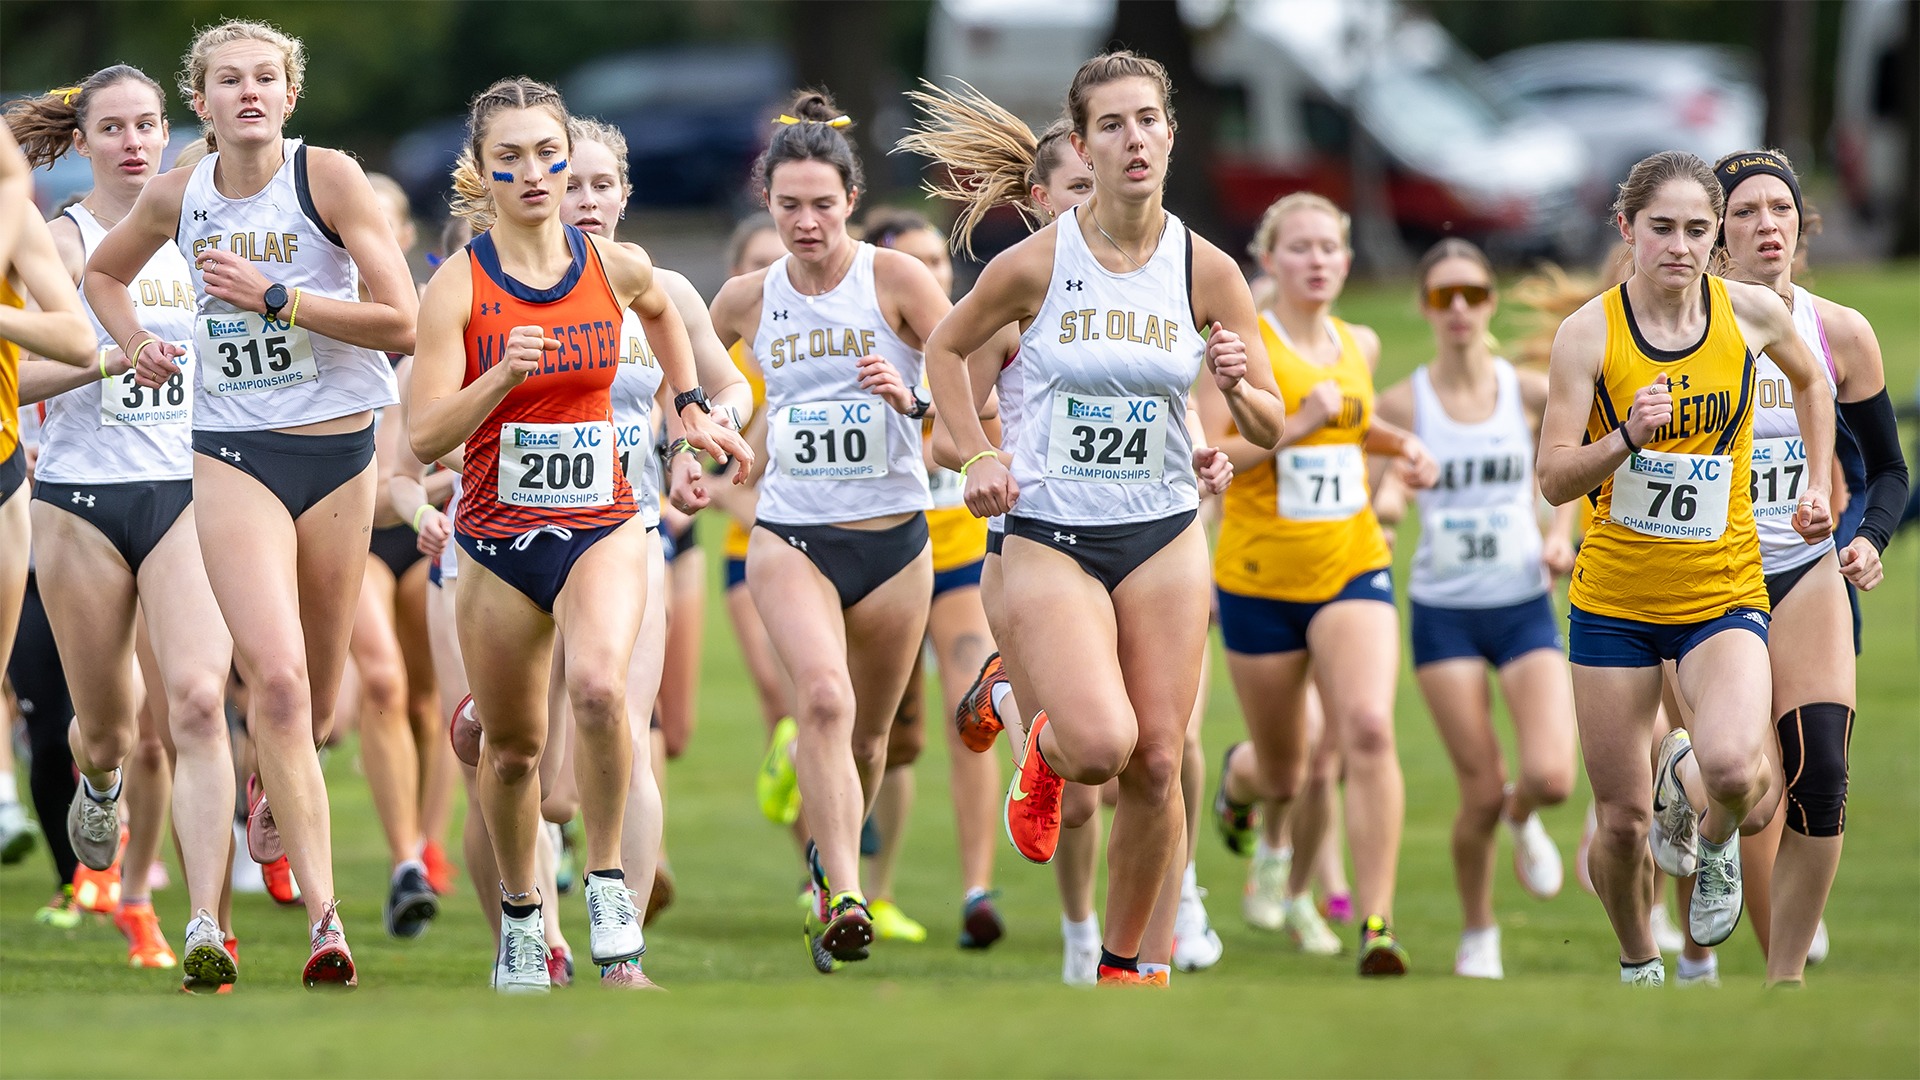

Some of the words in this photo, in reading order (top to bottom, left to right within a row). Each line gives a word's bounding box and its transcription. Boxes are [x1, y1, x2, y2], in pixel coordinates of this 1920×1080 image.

[230, 232, 298, 263] OLAF
[212, 321, 246, 335] MIAC
[1059, 309, 1099, 344] ST.
[1106, 310, 1178, 352] OLAF
[218, 336, 292, 378] 315
[771, 333, 804, 369] ST.
[809, 328, 876, 358] OLAF
[122, 372, 184, 408] 318
[218, 371, 303, 392] CHAMPIONSHIPS
[115, 409, 188, 422] CHAMPIONSHIPS
[791, 409, 827, 422] MIAC
[841, 403, 871, 425] XC
[1072, 402, 1112, 418] MIAC
[1125, 400, 1157, 423] XC
[520, 433, 559, 446] MIAC
[573, 426, 601, 449] XC
[616, 426, 640, 447] XC
[794, 428, 866, 464] 310
[1070, 425, 1148, 465] 324
[518, 453, 594, 490] 200
[790, 465, 873, 477] CHAMPIONSHIPS
[1061, 465, 1150, 480] CHAMPIONSHIPS
[1635, 457, 1674, 475] MIAC
[1688, 458, 1721, 481] XC
[511, 492, 599, 504] CHAMPIONSHIPS
[1310, 474, 1341, 504] 71
[1646, 481, 1698, 521] 76
[1623, 516, 1712, 537] CHAMPIONSHIPS
[1459, 533, 1498, 562] 38
